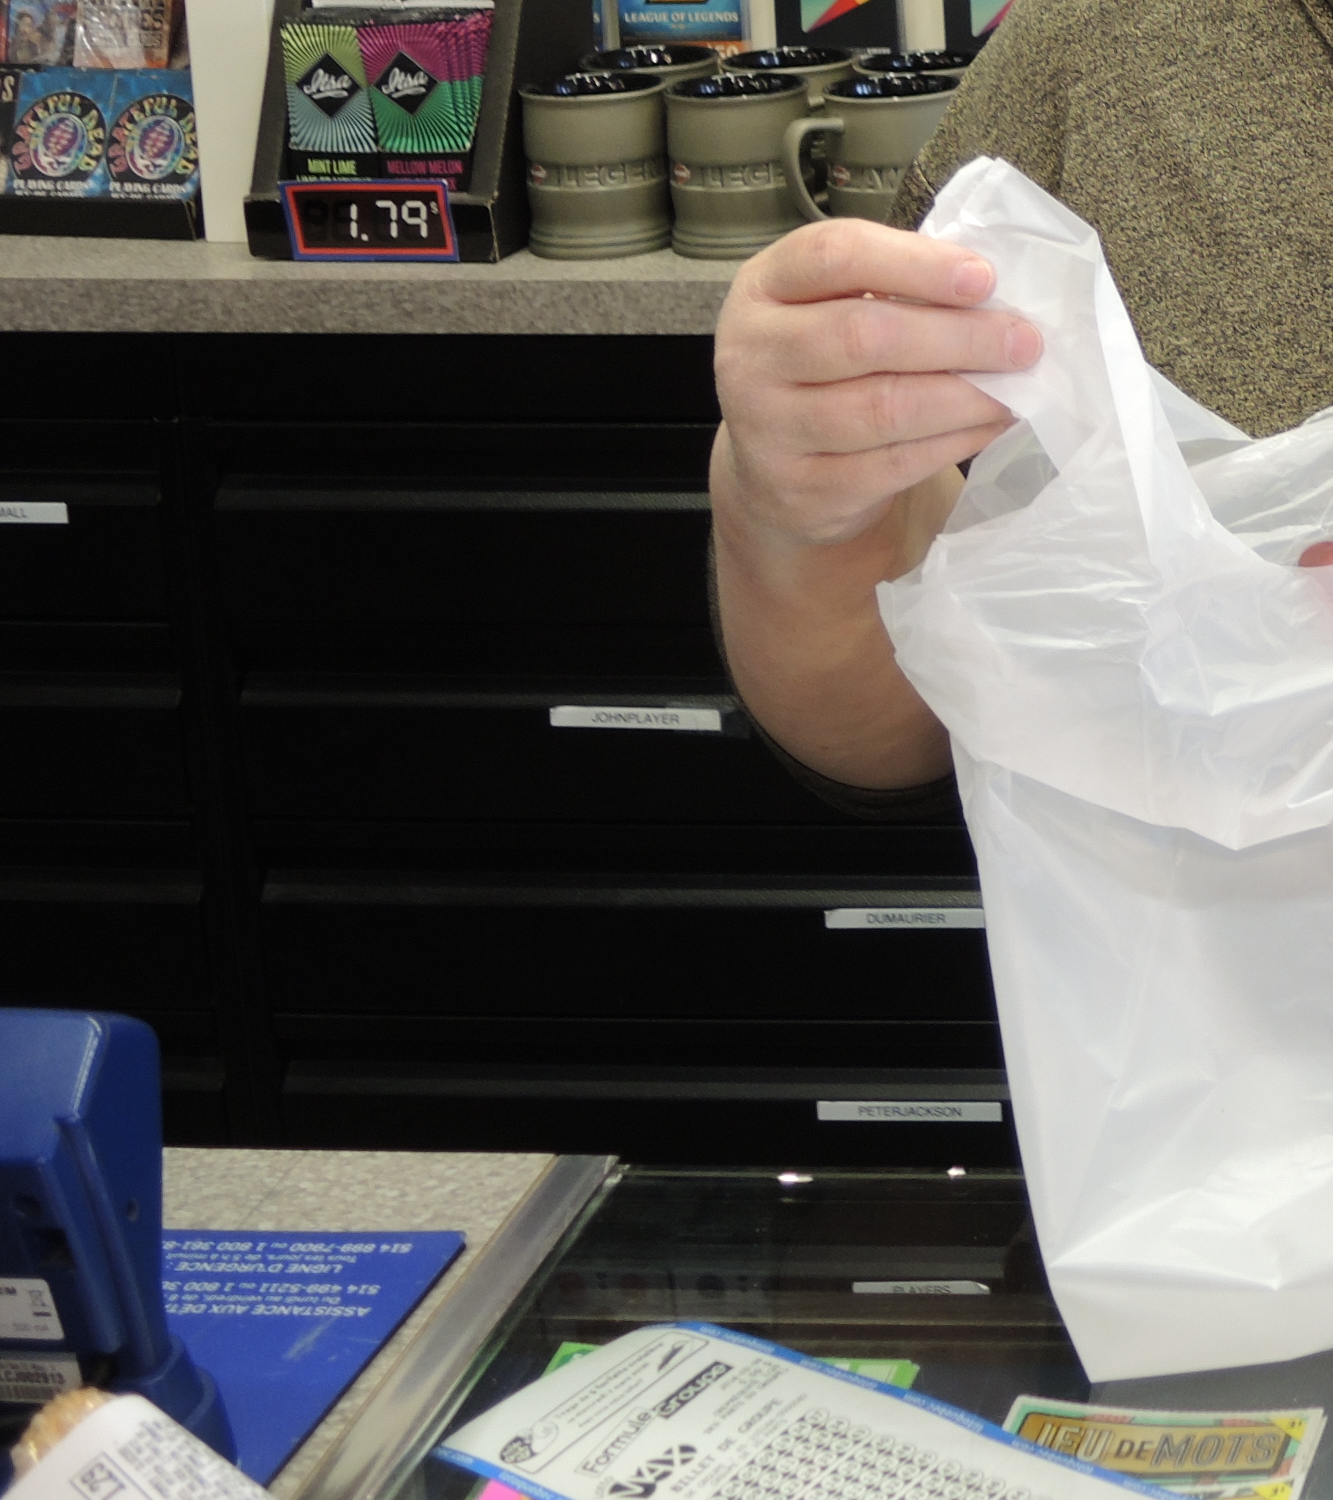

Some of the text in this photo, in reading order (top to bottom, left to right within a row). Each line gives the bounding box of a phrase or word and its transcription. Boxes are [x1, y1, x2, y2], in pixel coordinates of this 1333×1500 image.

[624, 11, 739, 23] LEAGUE OF LEGENDS
[307, 159, 357, 175] MINT LIME
[387, 159, 463, 175] MELLOW MELON
[590, 710, 681, 726] JOHNPLAYER
[866, 911, 947, 926] DUMAURIER
[857, 1103, 963, 1120] PETERJACKSON
[285, 1262, 344, 1274] LIGNE
[207, 1304, 372, 1317] ASSISTANCE AUX
[1114, 1432, 1282, 1468] DE MOTS
